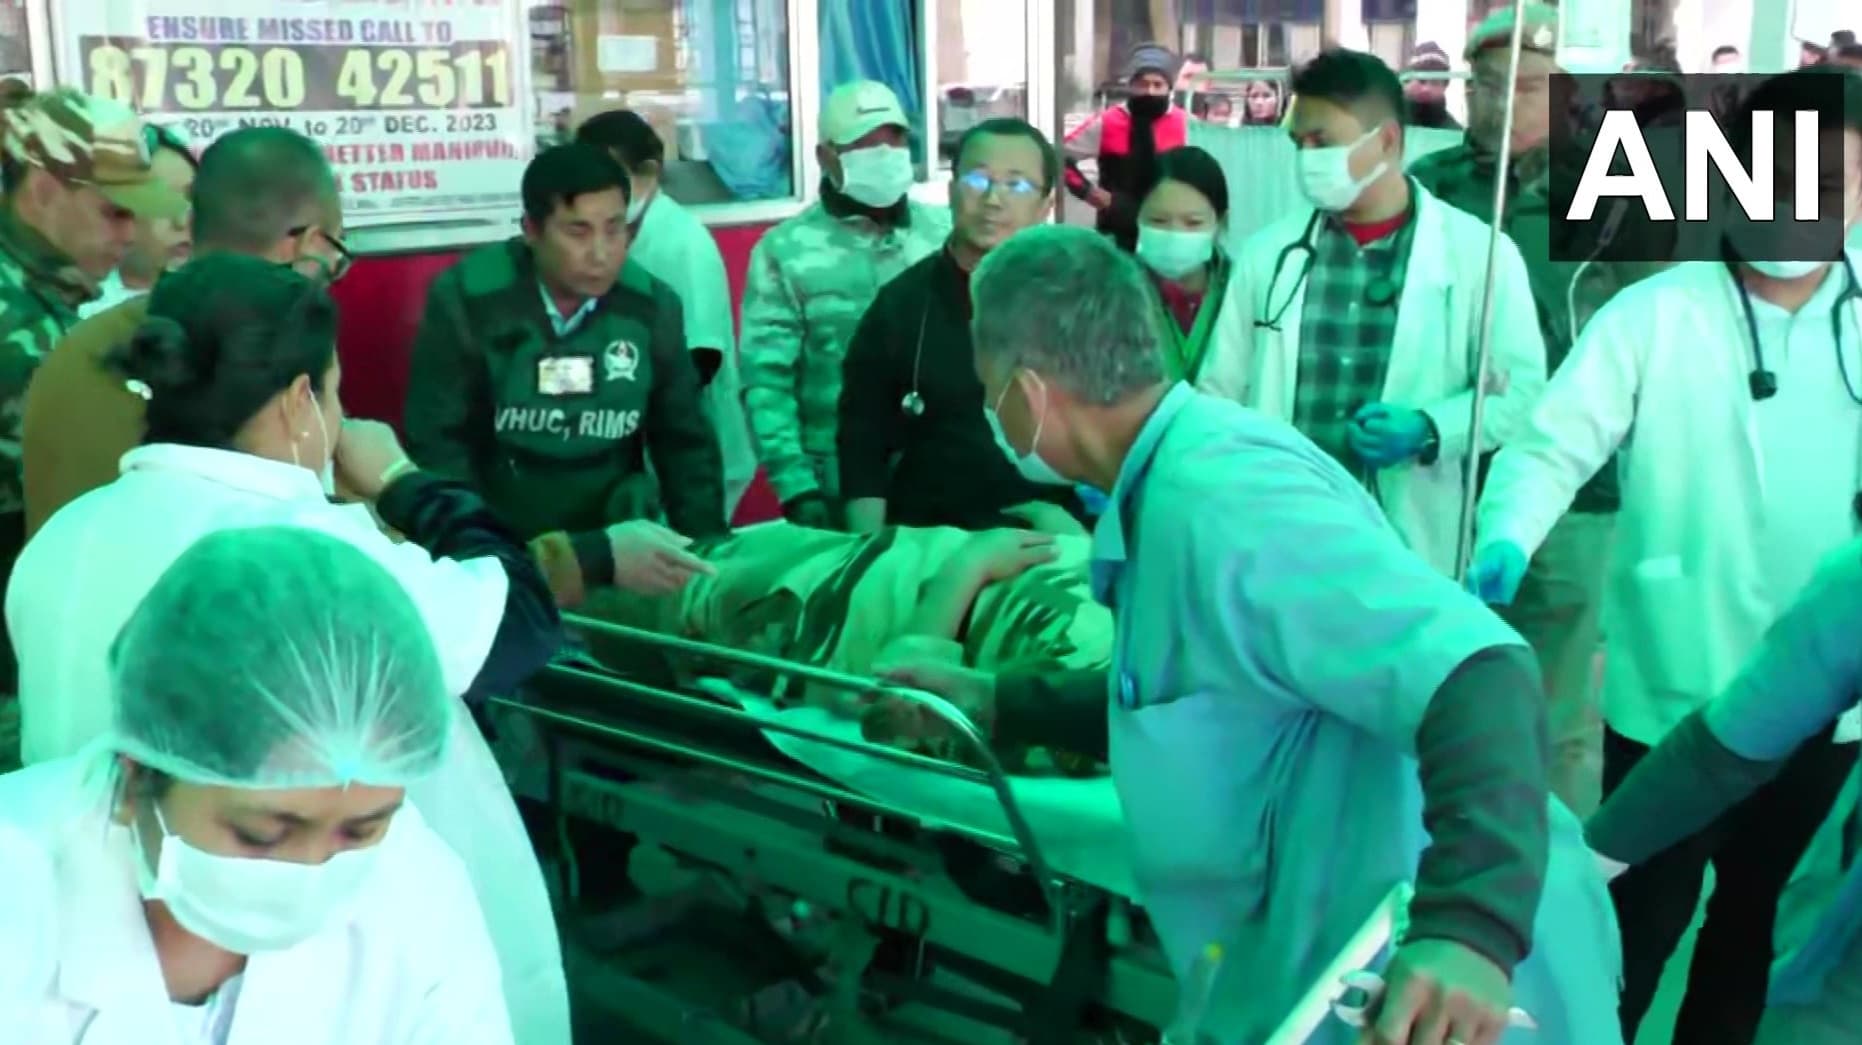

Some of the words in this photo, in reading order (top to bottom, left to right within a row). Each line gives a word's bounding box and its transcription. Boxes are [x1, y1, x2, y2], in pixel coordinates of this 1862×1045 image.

[148, 16, 249, 40] ENSURE
[258, 18, 353, 42] MISSED
[360, 19, 415, 42] CALL
[422, 20, 453, 42] TO
[90, 46, 305, 109] 87320
[337, 48, 509, 106] 42511
[304, 120, 327, 136] to
[384, 115, 438, 134] DEC.
[446, 113, 497, 132] 2023
[351, 170, 437, 193] STATUS
[578, 409, 641, 439] RIMS
